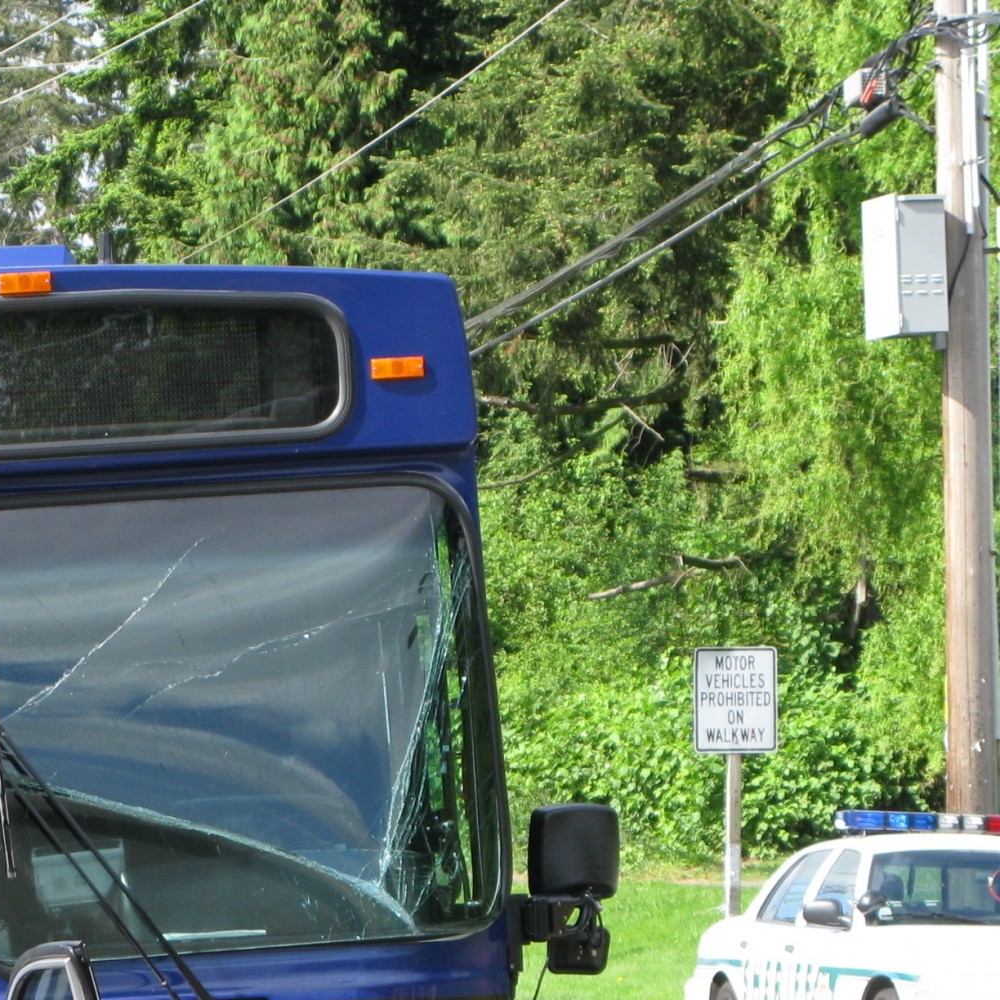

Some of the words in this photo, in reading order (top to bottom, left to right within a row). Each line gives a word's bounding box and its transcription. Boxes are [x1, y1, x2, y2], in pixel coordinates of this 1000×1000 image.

[715, 655, 756, 671] MOTOR
[705, 673, 766, 689] VEHICLES
[701, 692, 771, 707] PROHIBITED
[727, 709, 744, 725] ON
[706, 728, 765, 743] WALKWAY
